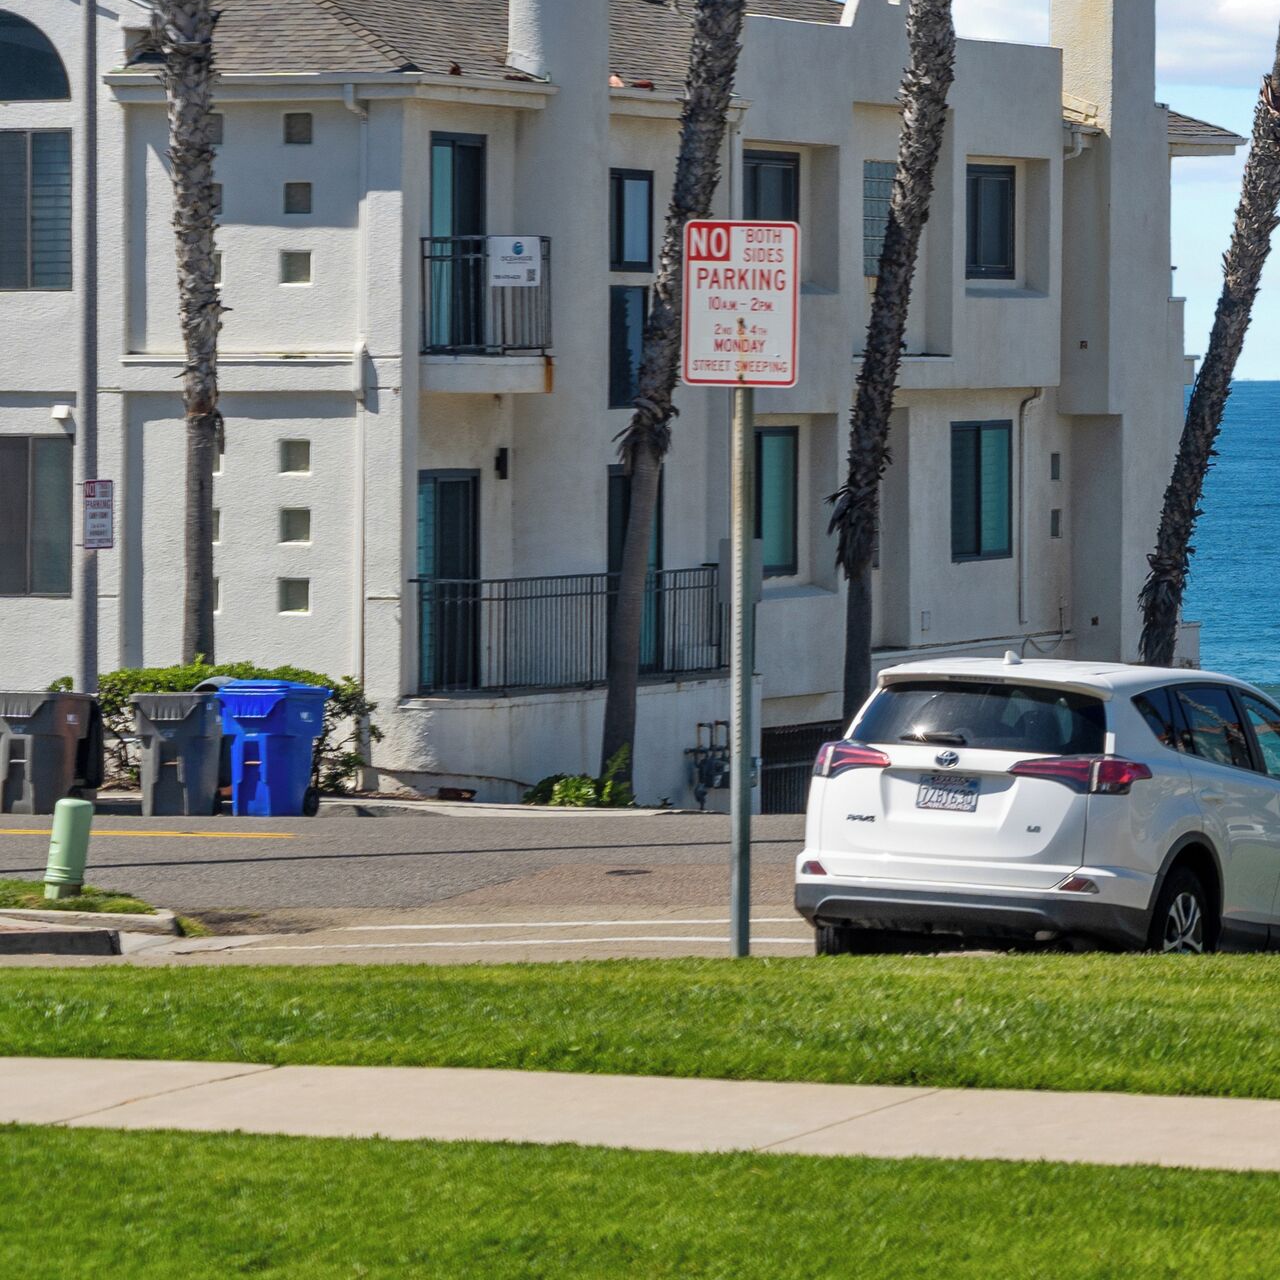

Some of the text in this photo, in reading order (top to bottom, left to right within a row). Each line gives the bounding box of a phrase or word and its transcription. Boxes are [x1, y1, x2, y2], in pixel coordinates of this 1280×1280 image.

[689, 227, 728, 258] NO
[745, 229, 782, 243] BOTH
[743, 248, 784, 263] SIDES
[696, 267, 787, 291] PARKING
[713, 338, 766, 353] MONDAY
[691, 359, 788, 374] STREET SWEEPING
